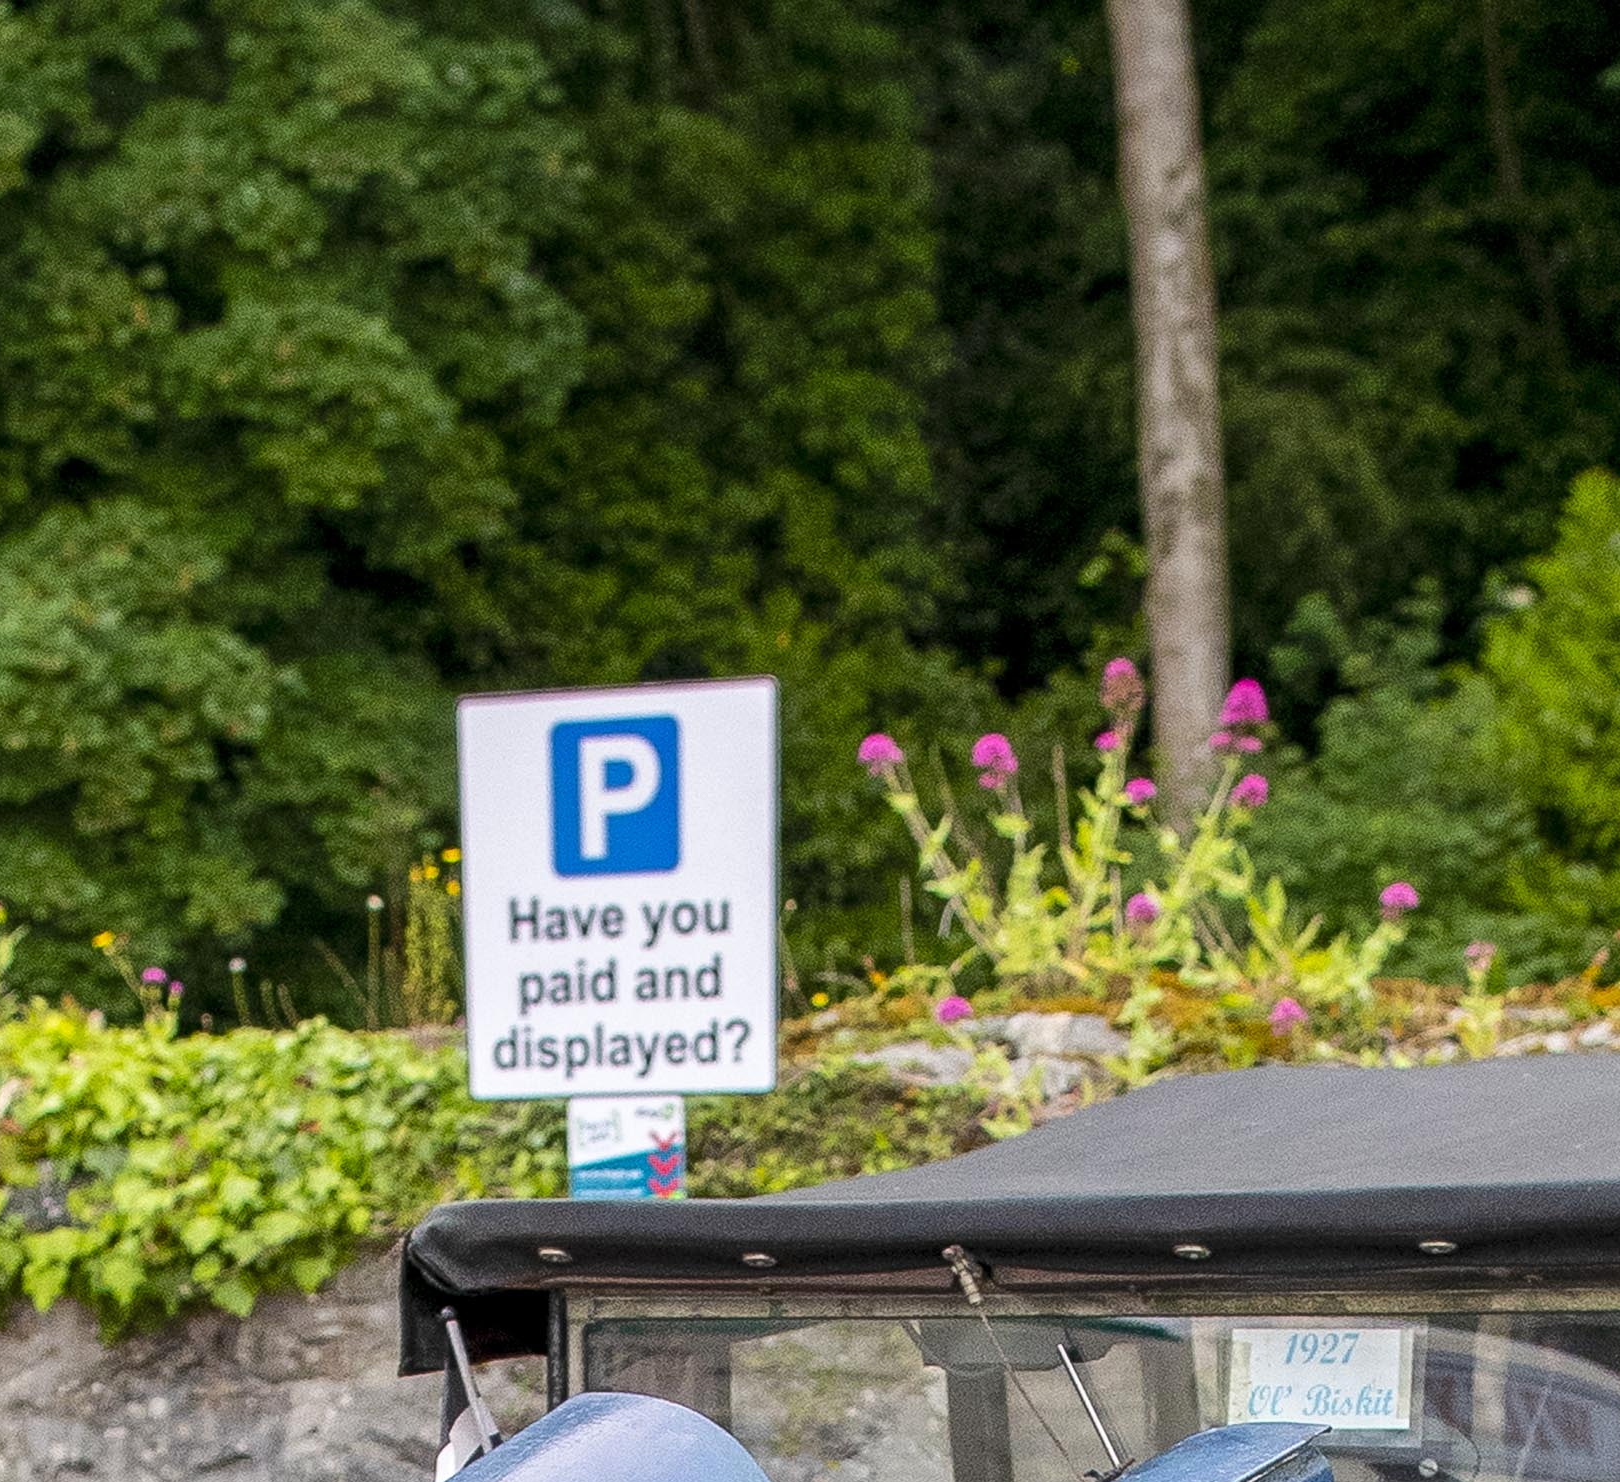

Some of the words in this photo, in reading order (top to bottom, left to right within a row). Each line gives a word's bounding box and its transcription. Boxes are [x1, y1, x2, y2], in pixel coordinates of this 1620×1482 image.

[579, 733, 662, 862] P
[508, 896, 626, 942] Have
[640, 897, 731, 949] you
[518, 957, 618, 1014] paid
[634, 954, 723, 1003] and
[491, 1018, 752, 1078] displayed?
[1283, 1332, 1360, 1365] 1927
[1301, 1383, 1396, 1417] Biskit
